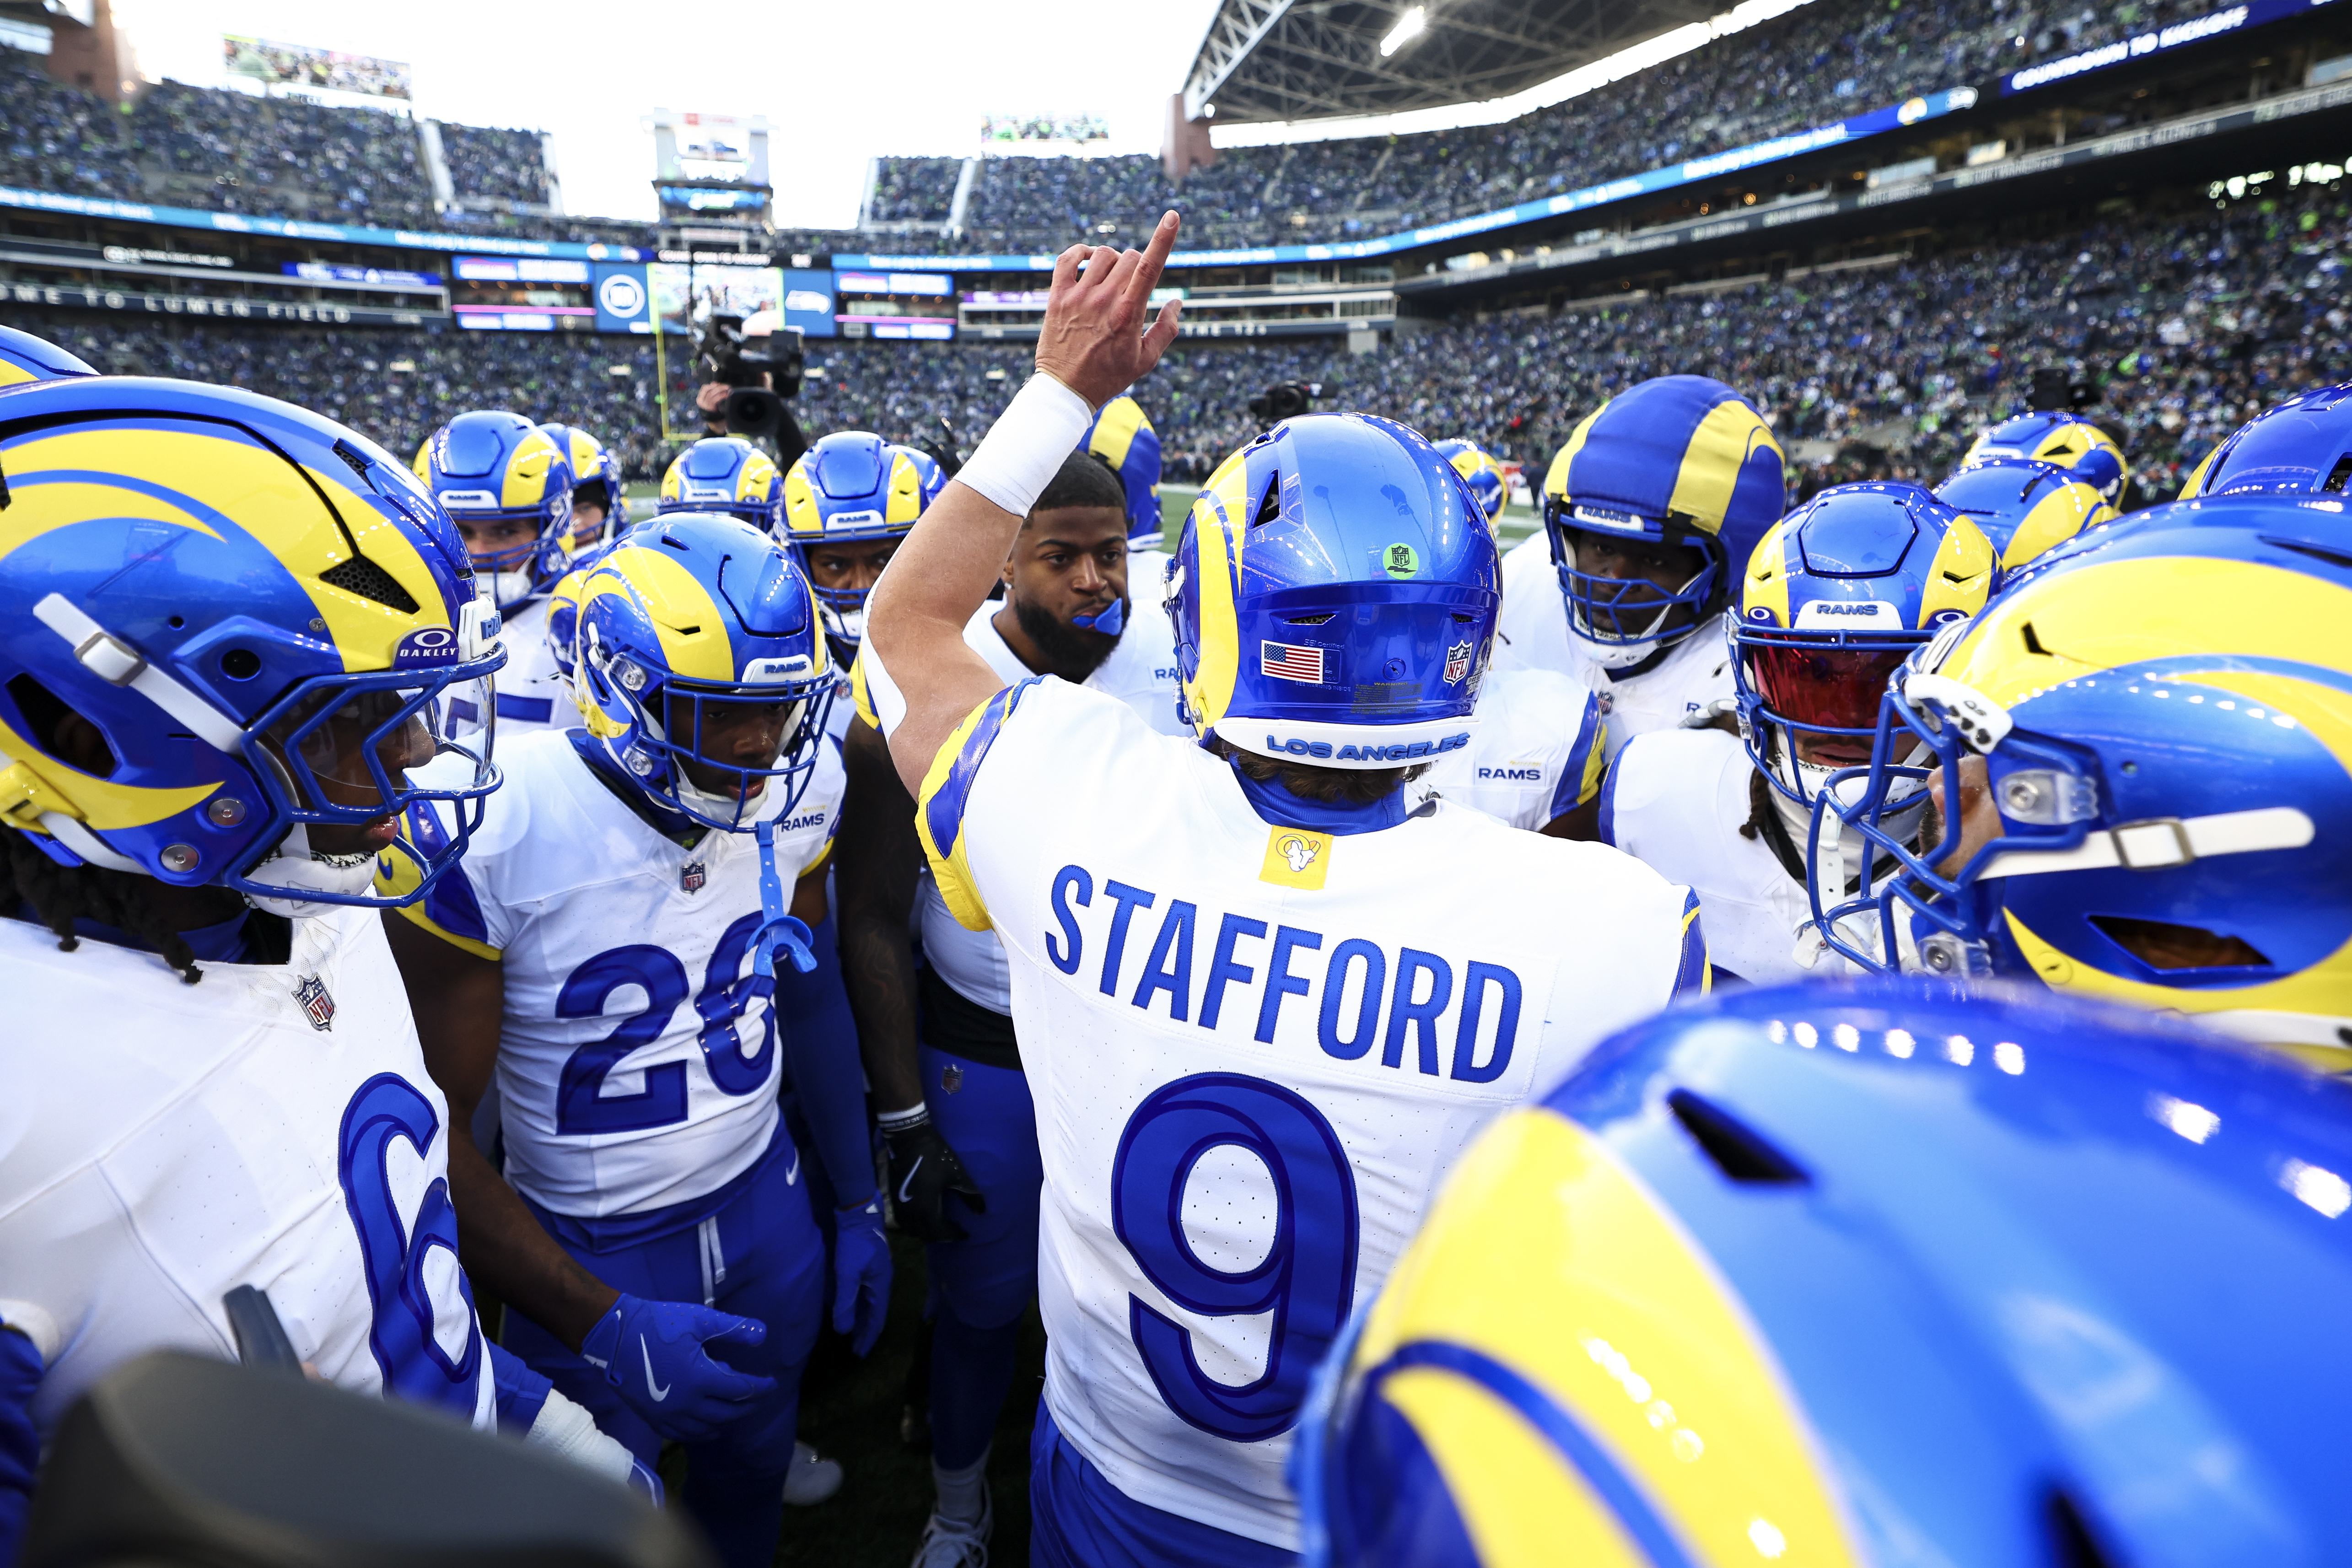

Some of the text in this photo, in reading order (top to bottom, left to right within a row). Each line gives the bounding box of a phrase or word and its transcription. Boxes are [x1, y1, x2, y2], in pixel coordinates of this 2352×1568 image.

[1394, 555, 1409, 565] NFL
[1817, 604, 1878, 615] RAMS
[399, 647, 456, 657] OAKLEY
[764, 661, 807, 674] RAMS
[1155, 668, 1177, 680] RA
[1447, 660, 1465, 679] NFL
[1266, 732, 1470, 761] LOS ANGELES
[1479, 767, 1541, 781] RAMS
[781, 813, 824, 832] RAMS
[684, 874, 703, 889] NFL
[1045, 864, 1523, 1084] STAFFORD
[308, 996, 333, 1023] NFL
[338, 1072, 483, 1427] 6
[1111, 1071, 1360, 1443] 9
